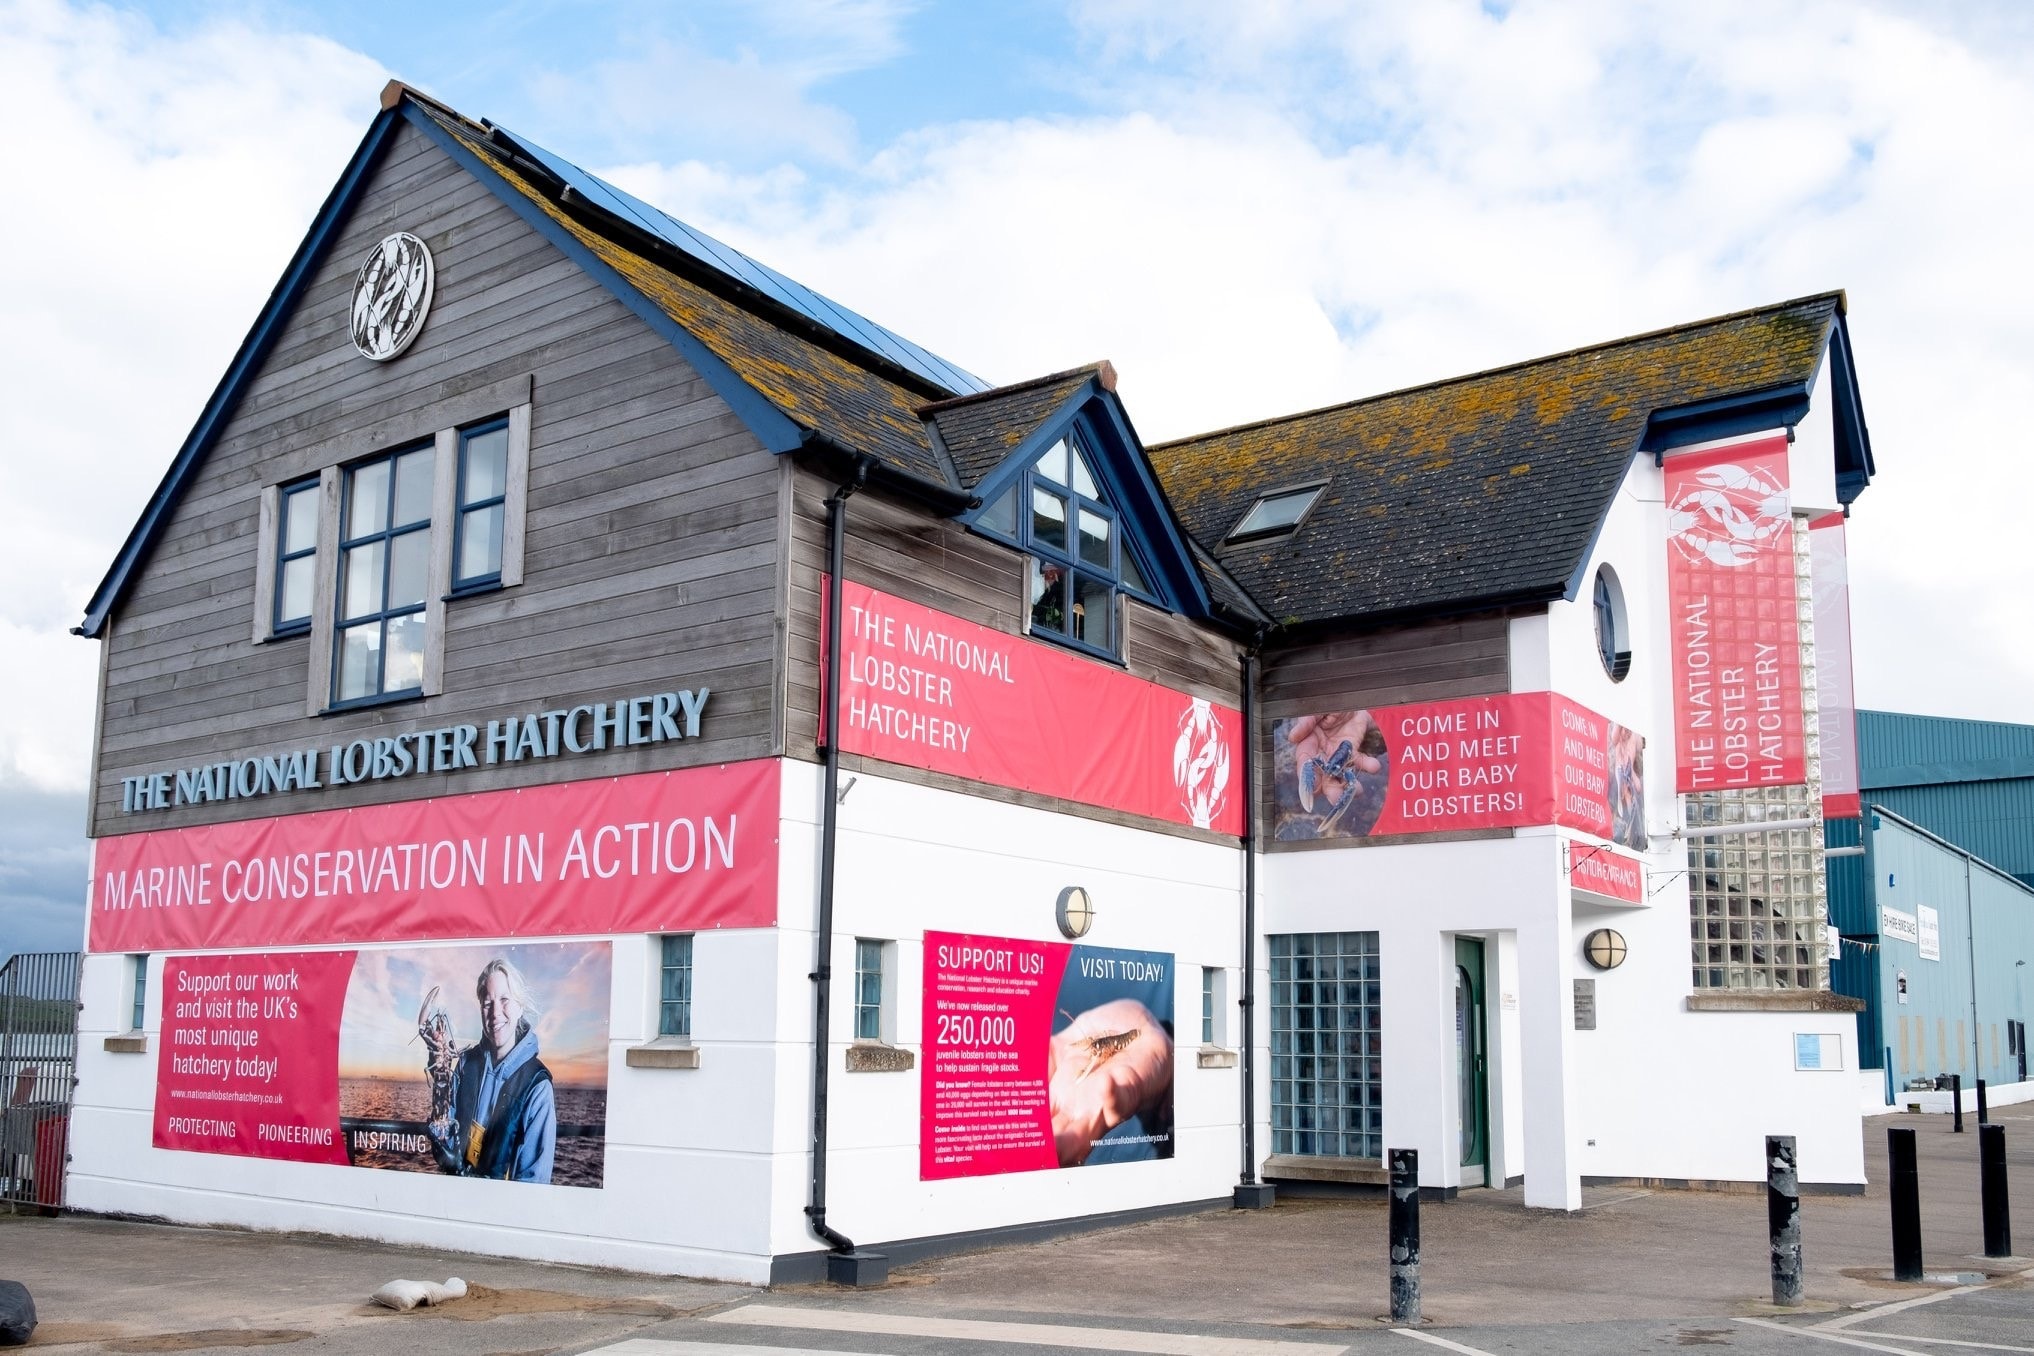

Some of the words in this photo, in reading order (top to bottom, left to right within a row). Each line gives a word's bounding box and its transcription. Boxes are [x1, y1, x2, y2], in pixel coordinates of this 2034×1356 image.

[850, 606, 895, 648] THE
[905, 624, 1014, 684] NATIONAL
[1686, 594, 1712, 729] NATIONAL
[850, 652, 952, 708] LOBSTER
[850, 697, 971, 753] HATCHERY
[1402, 713, 1466, 737] COME
[1476, 710, 1500, 729] IN
[1562, 709, 1588, 735] COME
[1589, 722, 1598, 740] IN
[1722, 666, 1748, 783] LOBSTER
[1755, 642, 1783, 781] HATCHERY
[121, 775, 172, 813] THE
[174, 750, 318, 806] NATIONAL
[330, 724, 478, 786] LOBSTER
[487, 687, 710, 765] HATCHERY
[1401, 740, 1450, 764] AND
[1460, 735, 1521, 758] MEET
[1564, 737, 1584, 760] AND
[1586, 745, 1604, 770] MEET
[1692, 736, 1714, 787] THE
[1402, 769, 1449, 791] OUR
[1459, 764, 1518, 787] BABY
[1565, 765, 1584, 788] OUR
[1587, 772, 1605, 796] BABY
[1403, 792, 1524, 818] LOBSTERS!
[104, 863, 211, 910] MARINE
[222, 838, 487, 904] CONSERVATION
[503, 832, 544, 884] IN
[559, 815, 736, 880] ACTION
[1576, 855, 1602, 878] VISITOR
[1603, 864, 1637, 888] ENTRANCE
[938, 945, 1013, 973] SUPPORT
[1019, 952, 1044, 974] US!
[1081, 958, 1115, 979] VISIT
[1120, 961, 1163, 982] TODAY!
[178, 970, 231, 995] Support
[235, 974, 258, 992] our
[263, 968, 298, 991] work
[176, 998, 201, 1019] and
[205, 998, 232, 1019] visit
[236, 996, 258, 1019] the
[263, 996, 298, 1019] UK's
[937, 1000, 956, 1010] We've
[957, 1002, 970, 1010] now
[971, 1001, 996, 1011] released
[174, 1028, 207, 1046] most
[211, 1027, 258, 1048] unique
[937, 1014, 1015, 1049] 250,000
[173, 1054, 231, 1080] hatchery
[235, 1057, 278, 1083] today!
[936, 1050, 960, 1060] juvenile
[961, 1050, 984, 1059] lobsters
[985, 1051, 996, 1059] into
[998, 1051, 1007, 1059] the
[936, 1064, 942, 1072] to
[944, 1063, 957, 1074] help
[958, 1063, 980, 1072] sustain
[981, 1063, 999, 1074] fragile
[171, 1089, 282, 1105] www.nationallobsterhatchery.co.uk
[169, 1118, 236, 1137] PROTECTING
[258, 1123, 332, 1146] PIONEERING
[354, 1130, 426, 1153] INSPIRING
